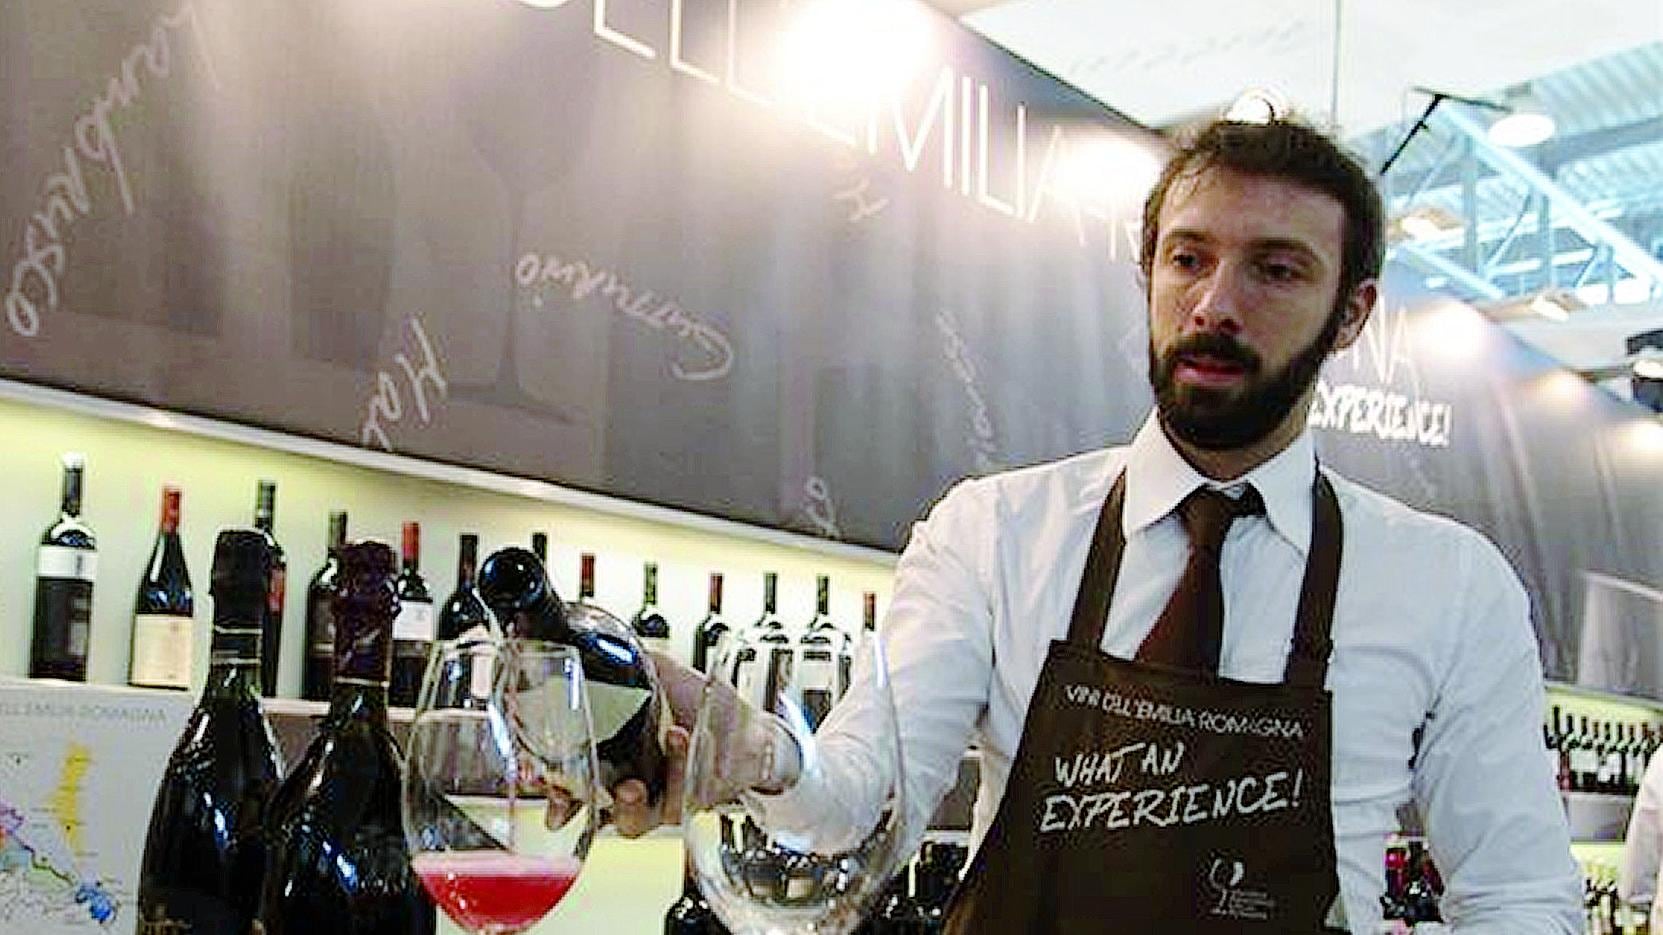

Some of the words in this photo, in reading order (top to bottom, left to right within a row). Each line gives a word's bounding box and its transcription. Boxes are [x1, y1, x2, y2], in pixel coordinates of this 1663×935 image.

[1054, 743, 1146, 788] WHAT
[1142, 742, 1185, 775] AN
[1040, 768, 1304, 833] EXPERIENCE!
